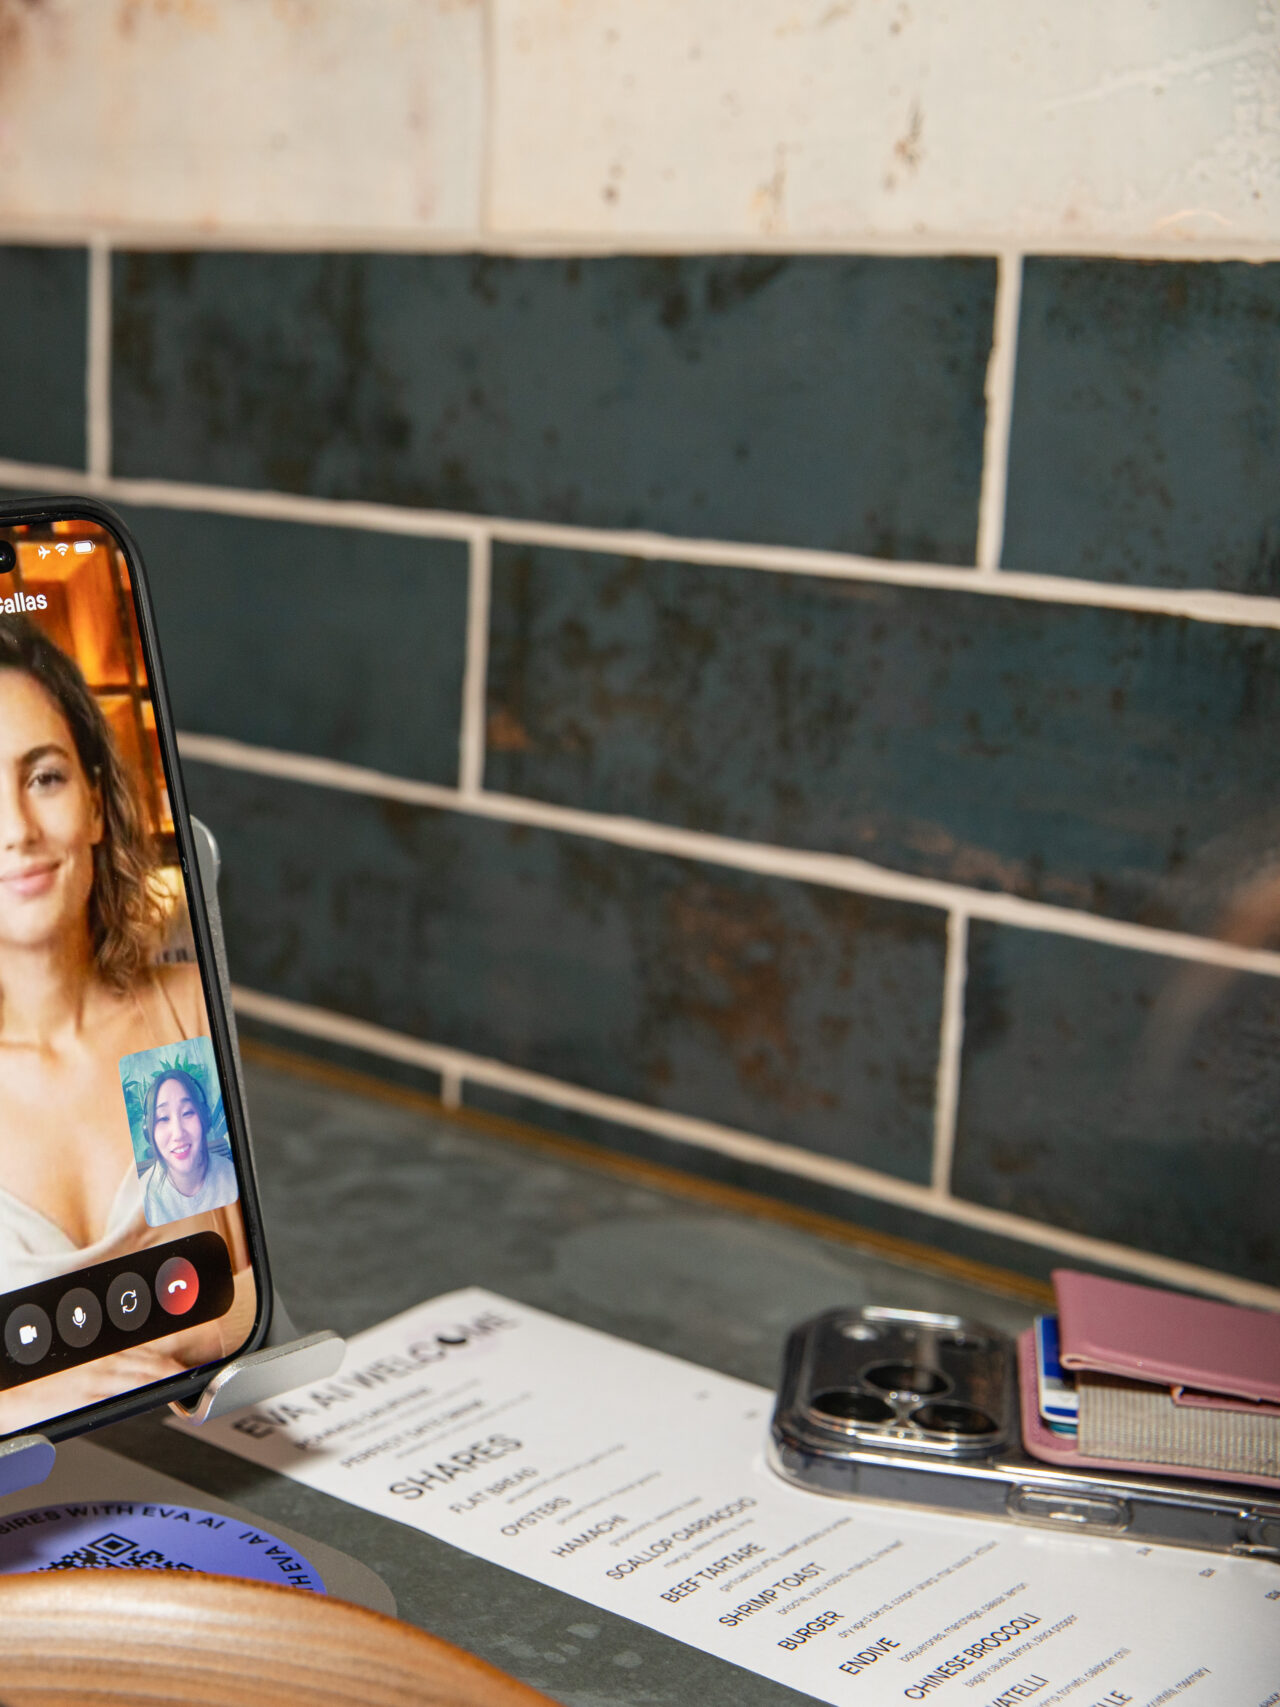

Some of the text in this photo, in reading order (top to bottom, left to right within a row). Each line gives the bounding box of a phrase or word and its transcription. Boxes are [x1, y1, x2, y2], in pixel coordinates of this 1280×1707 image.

[388, 1432, 524, 1502] SHARES
[64, 1503, 135, 1519] WITH
[141, 1504, 192, 1523] EVA
[198, 1512, 226, 1531] AI
[448, 1487, 488, 1516] FLAT
[499, 1494, 573, 1538] OYSTERS
[550, 1513, 630, 1559] HAMACHI
[604, 1536, 676, 1582] SCALLOP
[669, 1495, 759, 1544] CARPACCIO
[659, 1577, 704, 1605] BEEF
[694, 1541, 767, 1583] TARTARE
[717, 1561, 828, 1628] SHRIMP TOAST
[776, 1609, 846, 1652] BURGER
[837, 1635, 902, 1676] ENDIVE
[903, 1611, 1043, 1702] CHINESE BROCCOLI
